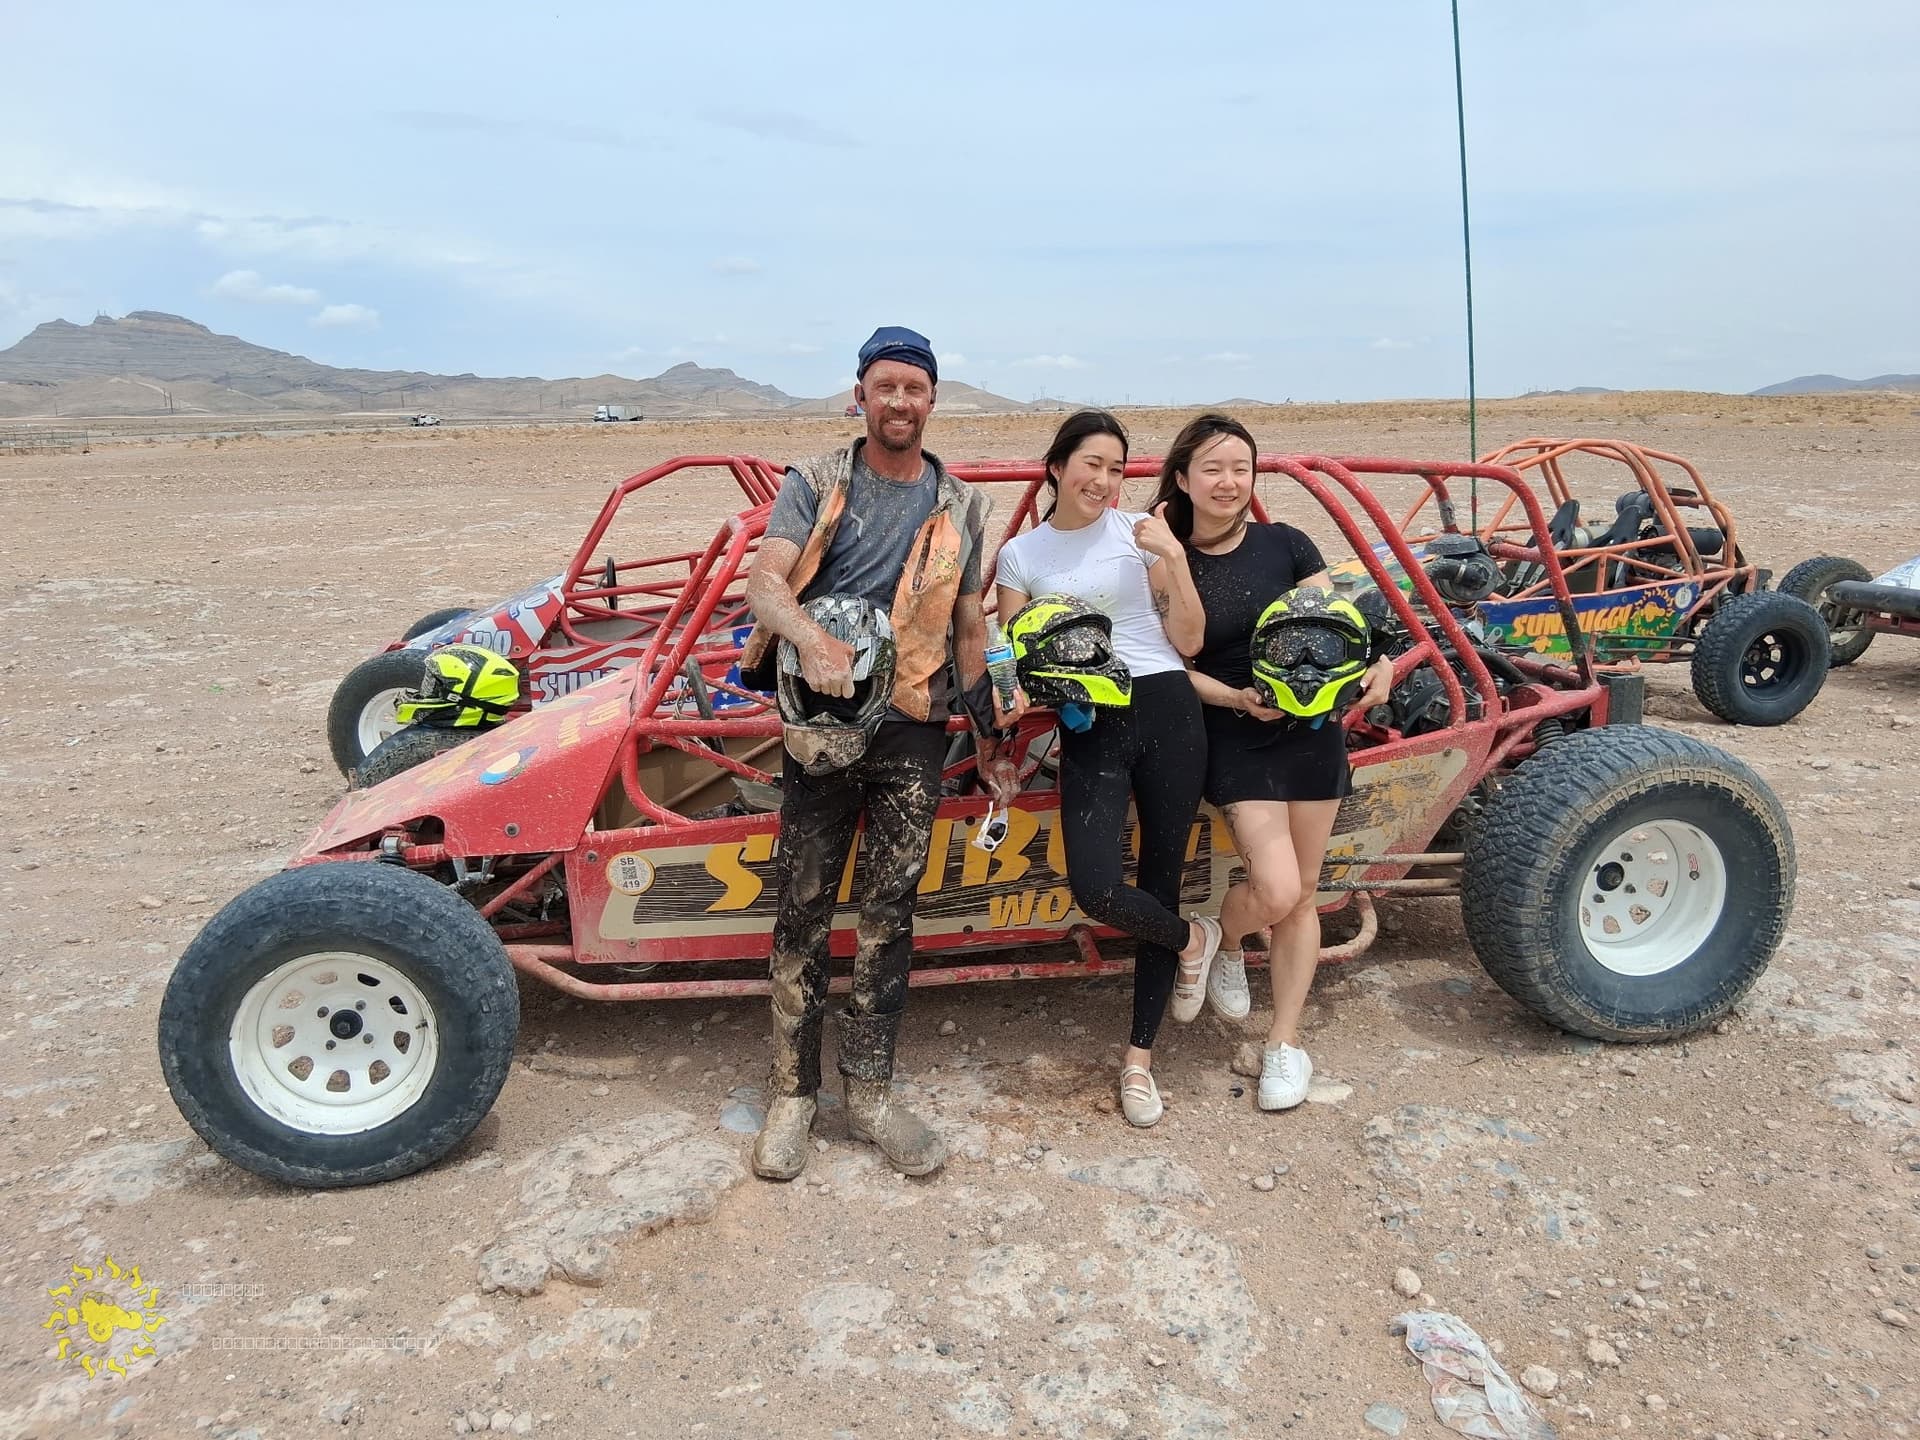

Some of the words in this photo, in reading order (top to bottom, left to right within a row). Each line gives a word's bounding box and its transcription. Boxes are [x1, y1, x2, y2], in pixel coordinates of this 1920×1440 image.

[1511, 603, 1633, 638] SUNUGGY
[620, 857, 635, 866] SB
[622, 880, 641, 889] 419
